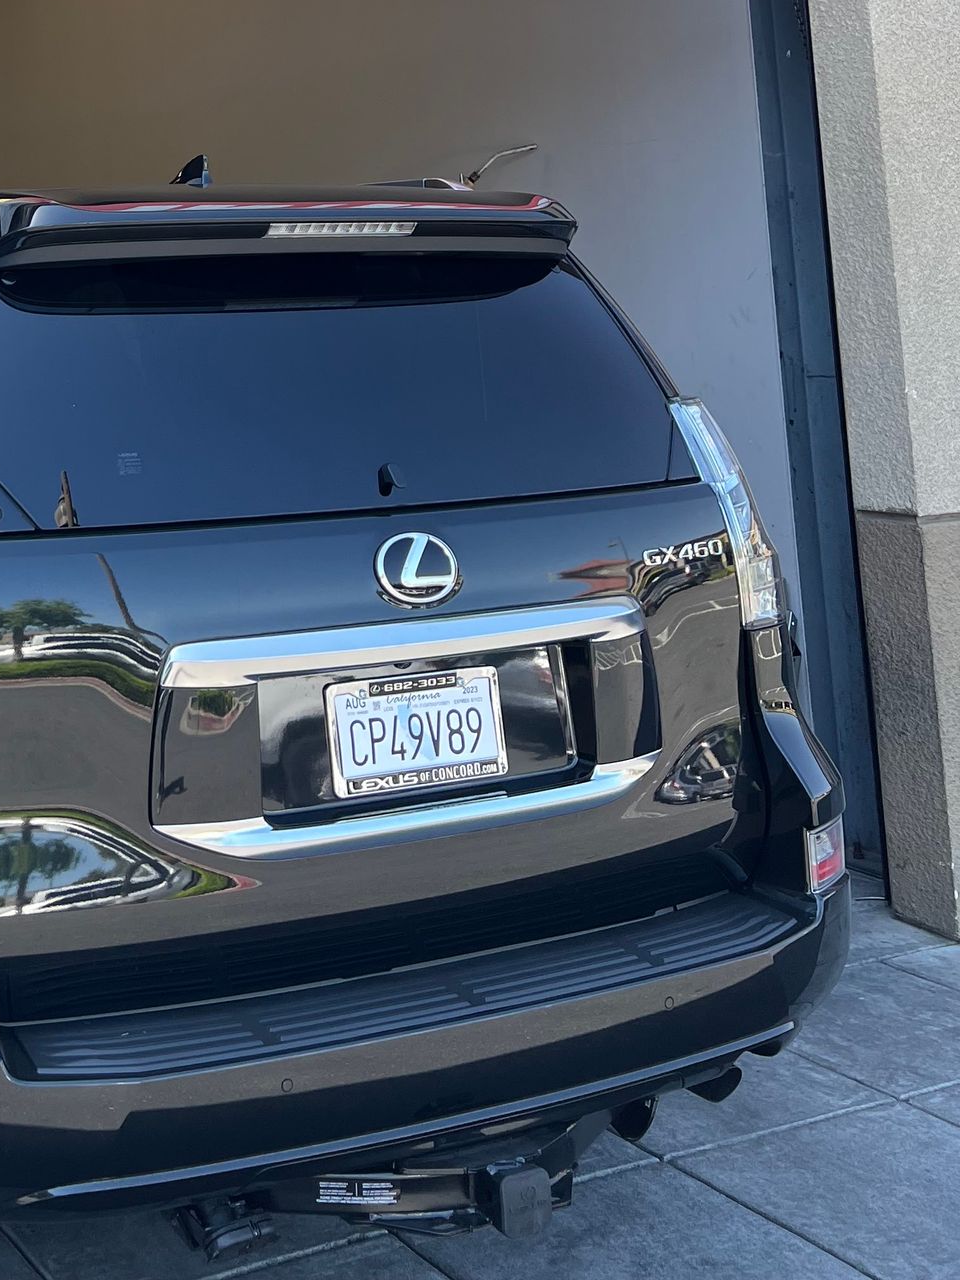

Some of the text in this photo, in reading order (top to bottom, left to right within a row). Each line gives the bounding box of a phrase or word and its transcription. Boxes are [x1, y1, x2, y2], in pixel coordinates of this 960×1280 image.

[383, 676, 456, 693] 682-3033
[462, 685, 479, 694] 2023
[345, 698, 367, 709] AUG
[386, 691, 441, 709] California
[349, 706, 483, 767] CP49V89
[348, 772, 419, 794] LEXUS
[419, 771, 431, 782] OF
